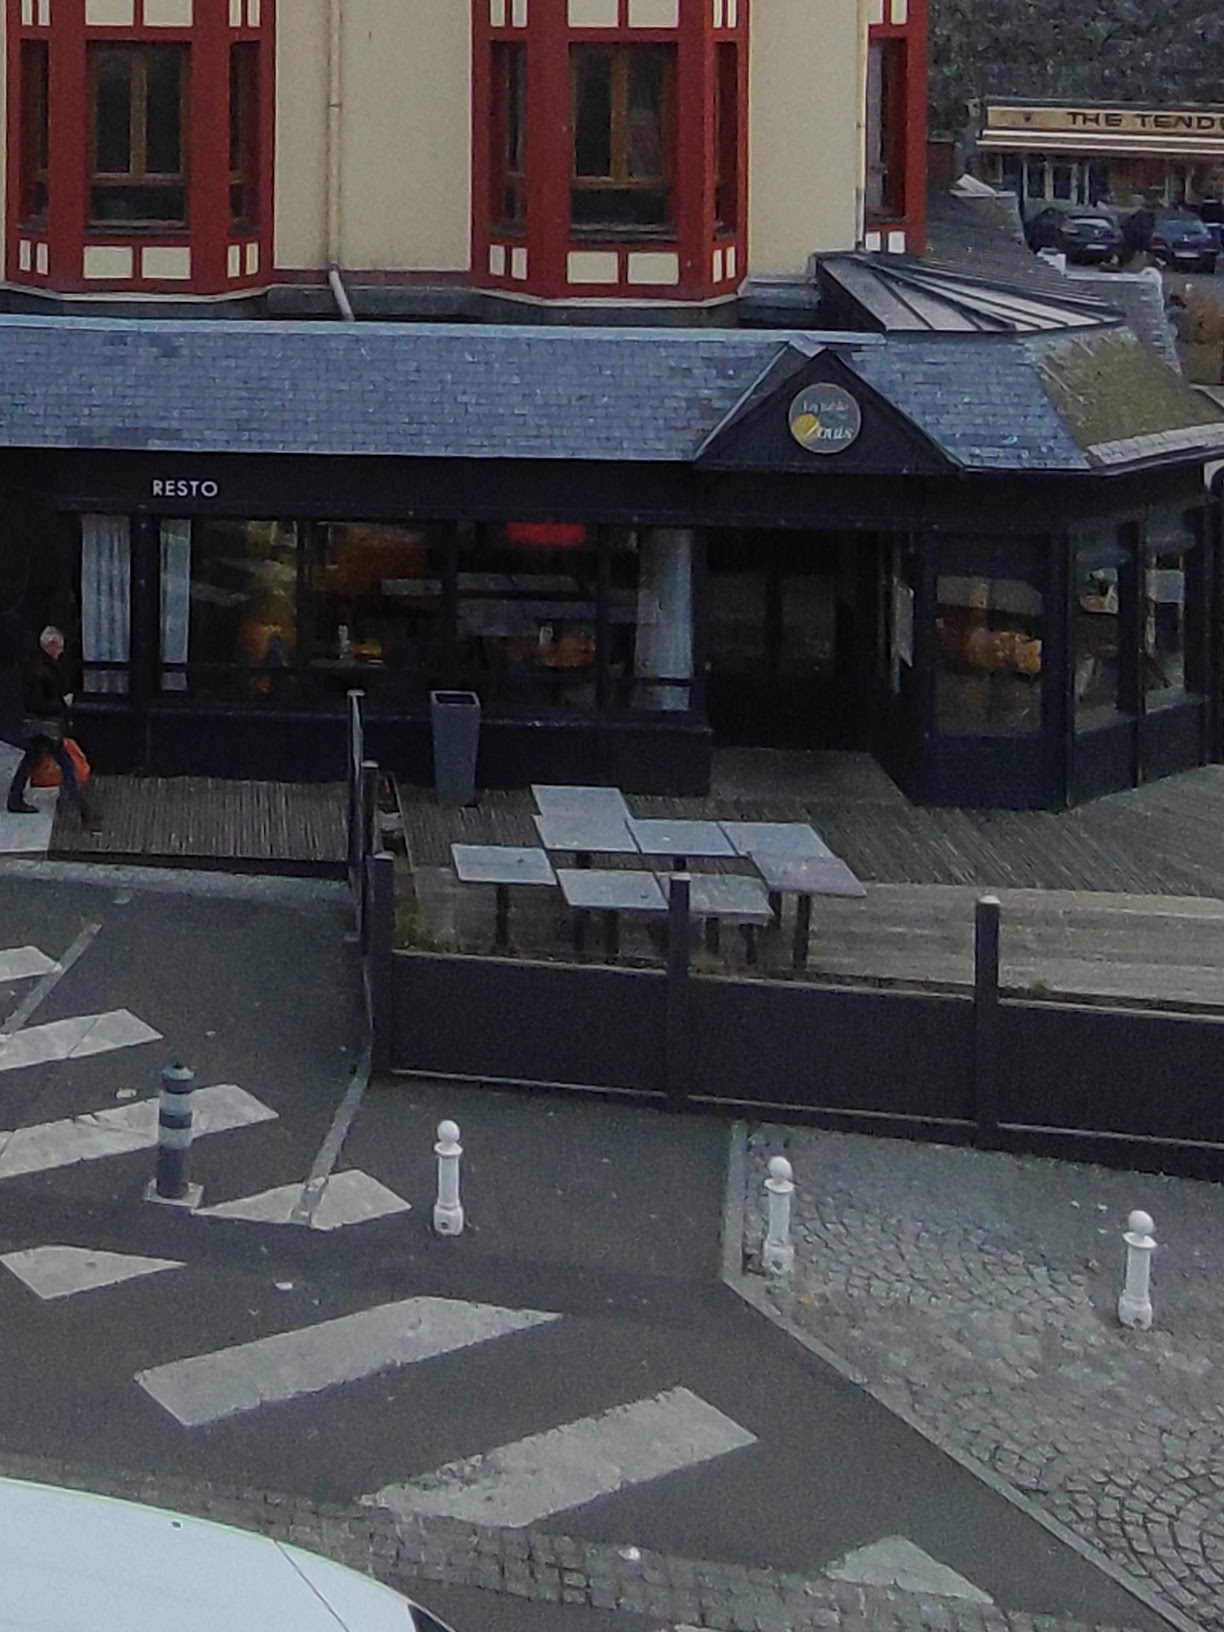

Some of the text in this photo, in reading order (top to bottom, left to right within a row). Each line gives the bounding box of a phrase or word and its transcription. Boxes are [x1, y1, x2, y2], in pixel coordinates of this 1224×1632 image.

[1067, 112, 1224, 130] THE TEND
[152, 479, 218, 497] RESTO
